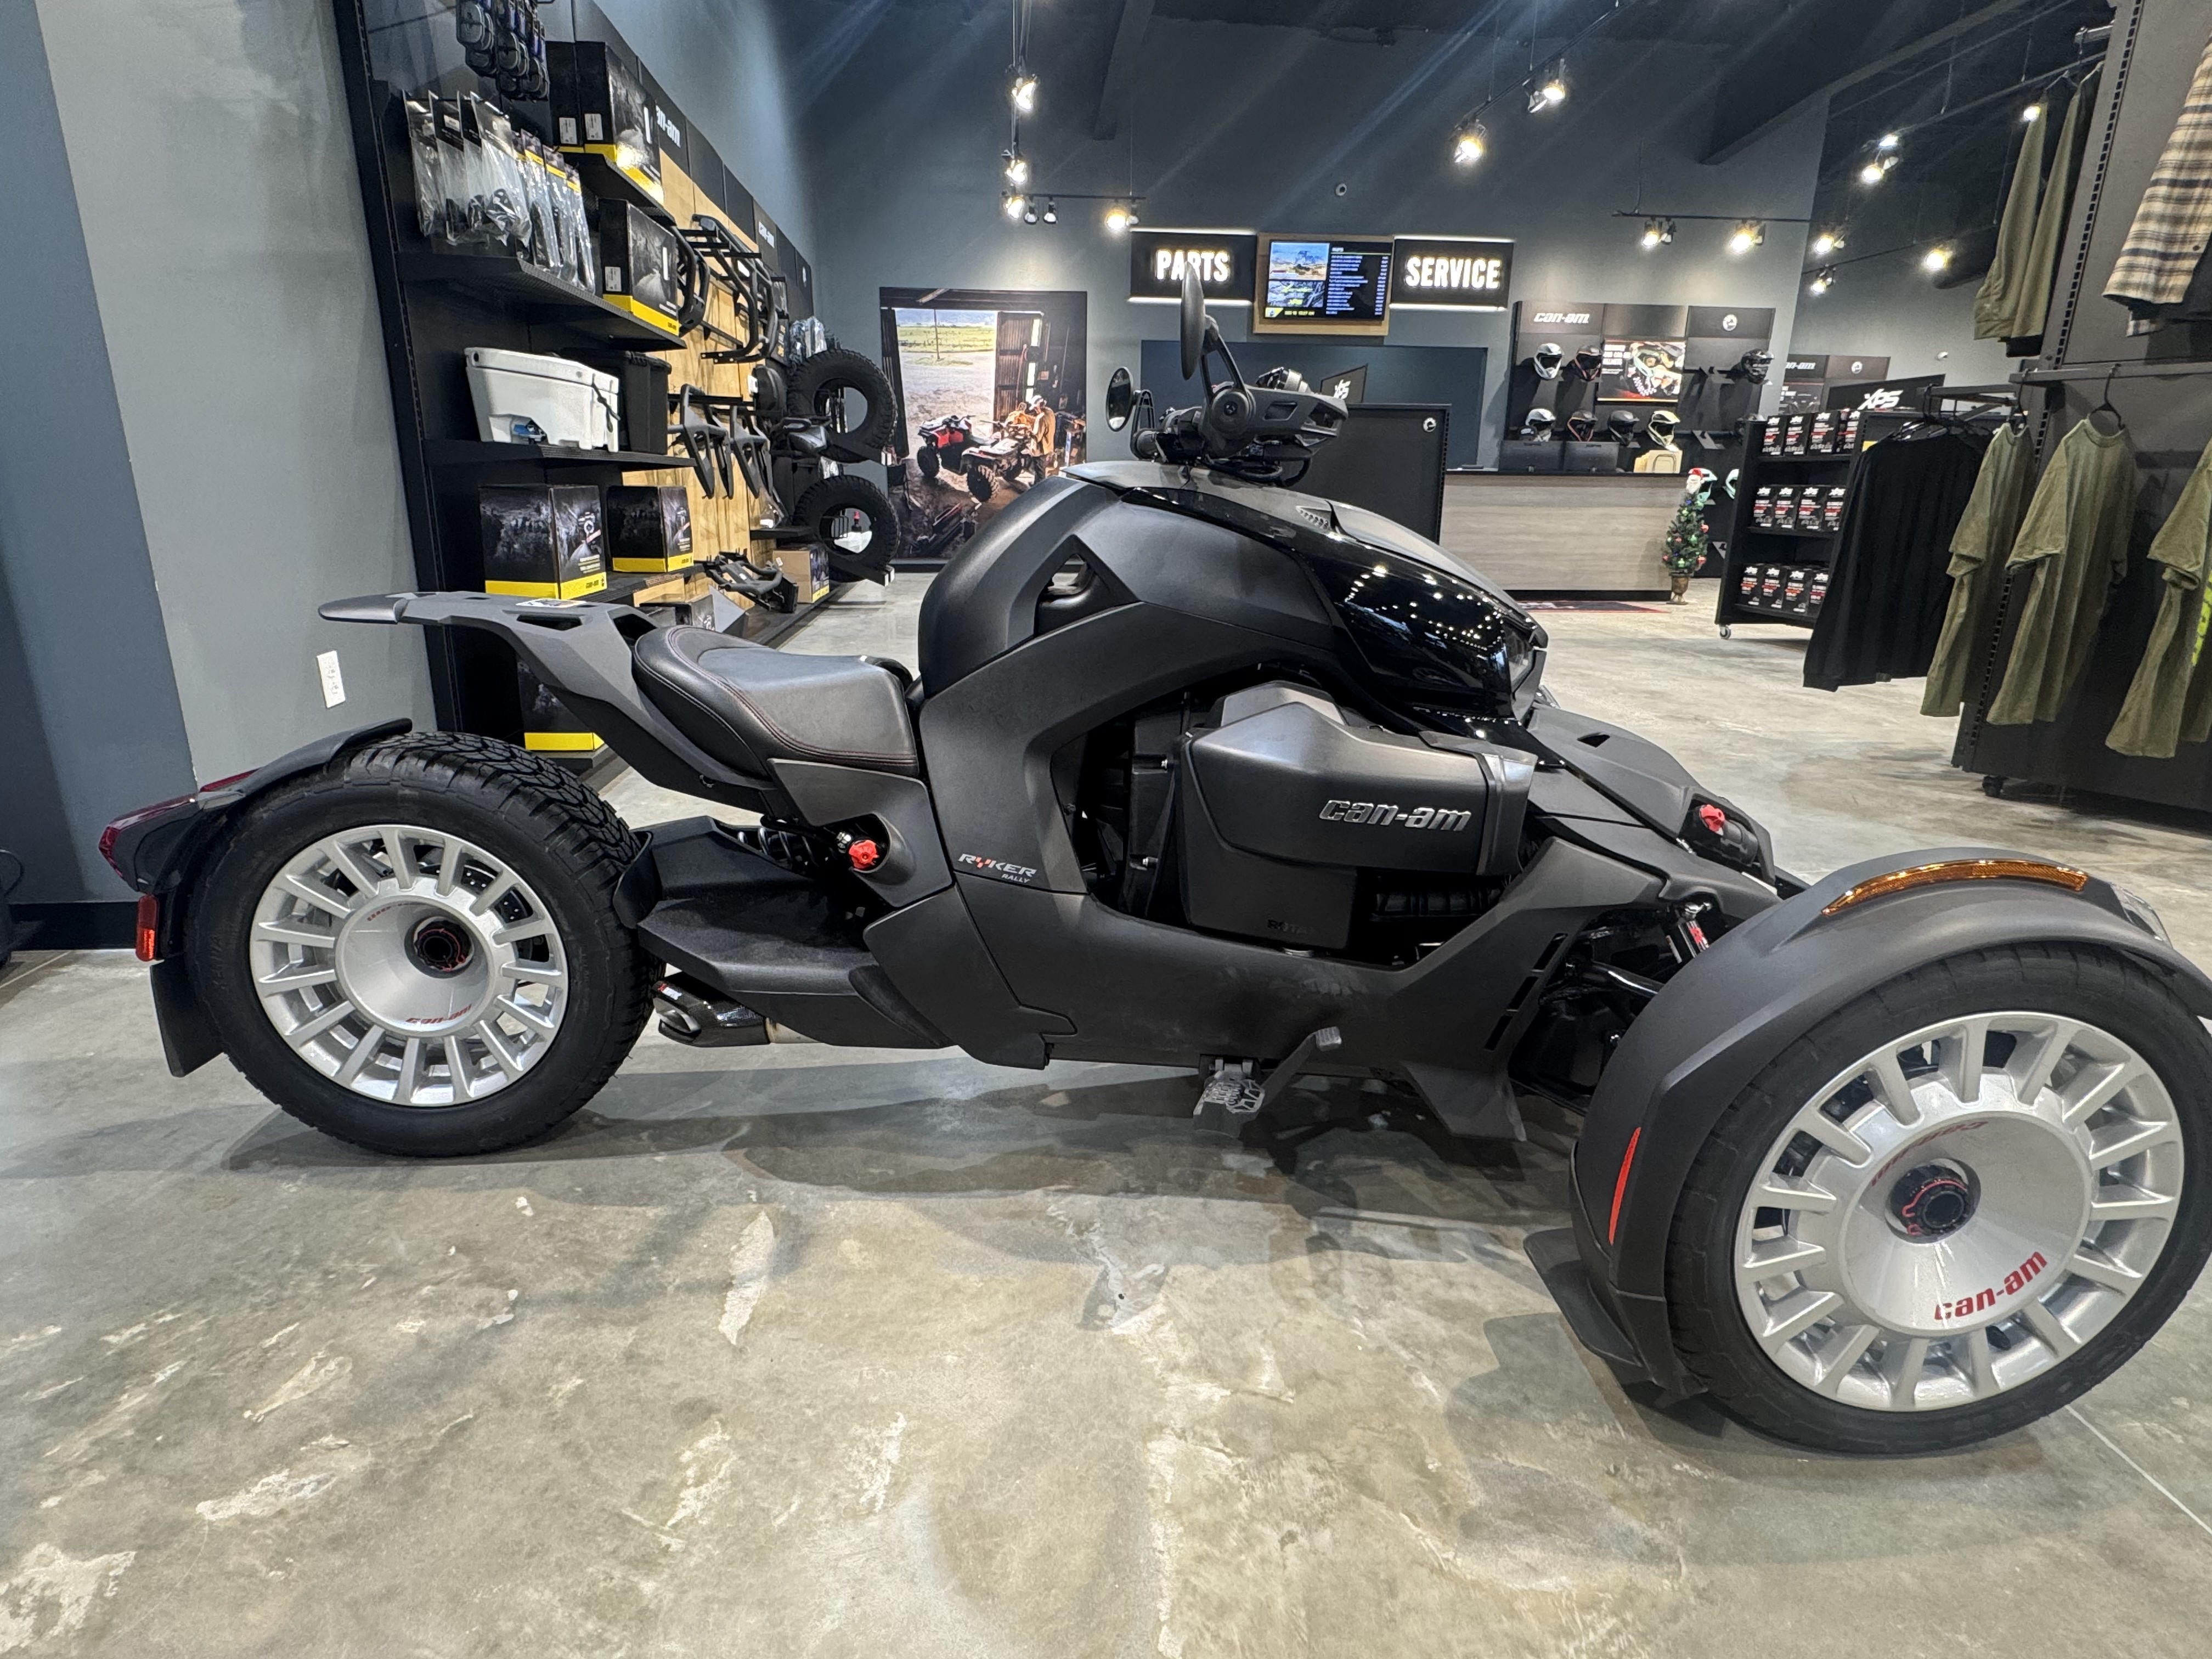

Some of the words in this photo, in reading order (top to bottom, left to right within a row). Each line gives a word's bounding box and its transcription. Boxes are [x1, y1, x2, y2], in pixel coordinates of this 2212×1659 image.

[656, 105, 681, 148] an-am
[1156, 249, 1229, 281] PARTS
[1405, 257, 1502, 289] SERVICE
[1534, 313, 1590, 323] can-am
[1857, 388, 1904, 410] XPS
[1319, 799, 1471, 831] can-am
[958, 853, 1037, 877] RYKER
[1001, 873, 1030, 883] RALLY
[1934, 1251, 2047, 1321] can-am
